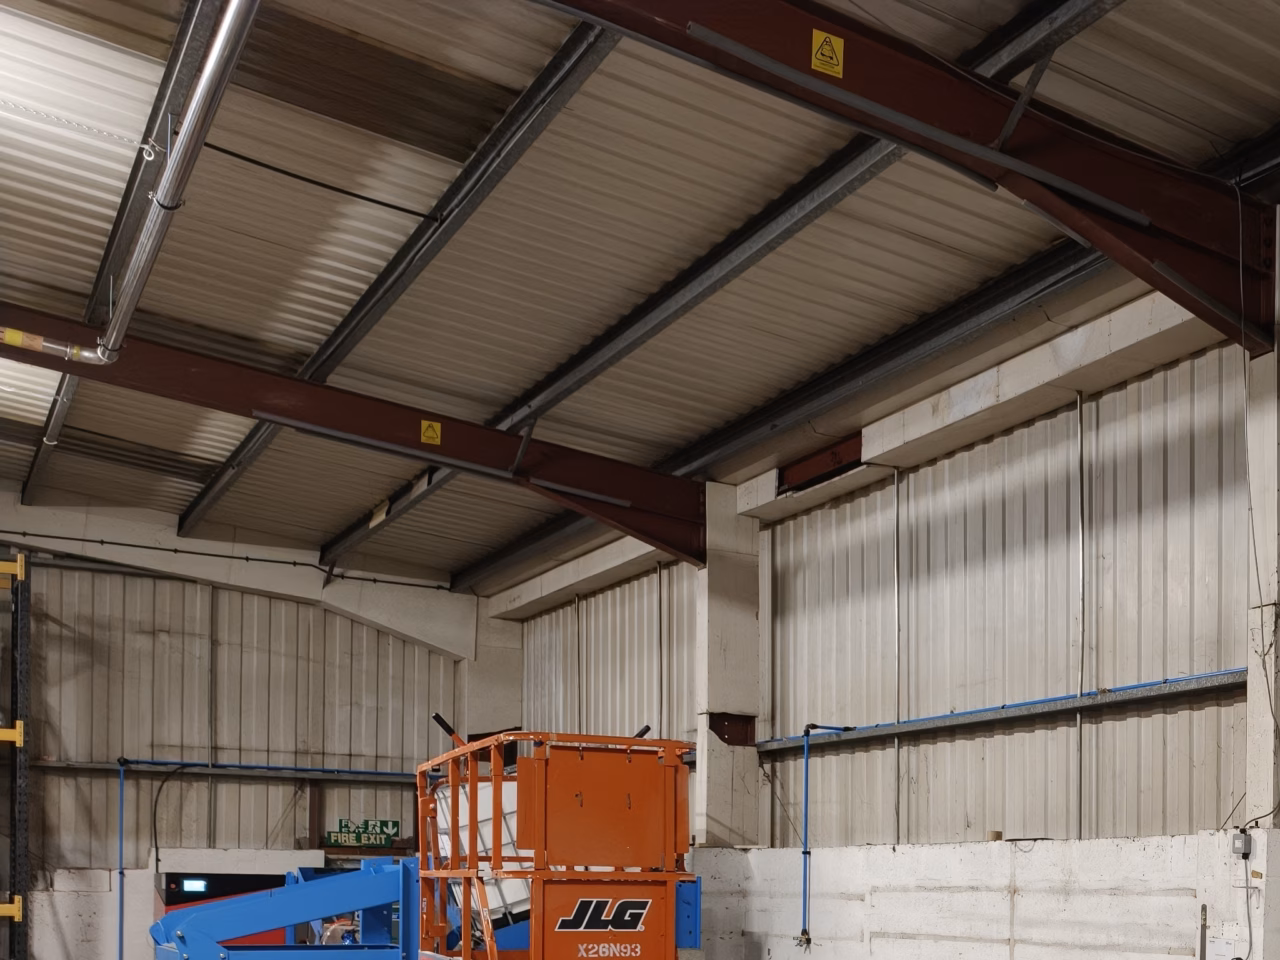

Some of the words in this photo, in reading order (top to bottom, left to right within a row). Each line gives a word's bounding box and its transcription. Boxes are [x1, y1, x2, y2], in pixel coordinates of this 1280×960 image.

[330, 833, 357, 844] FIRE
[361, 833, 387, 845] EXIT
[554, 898, 653, 932] JLG
[577, 943, 641, 958] X26N93
